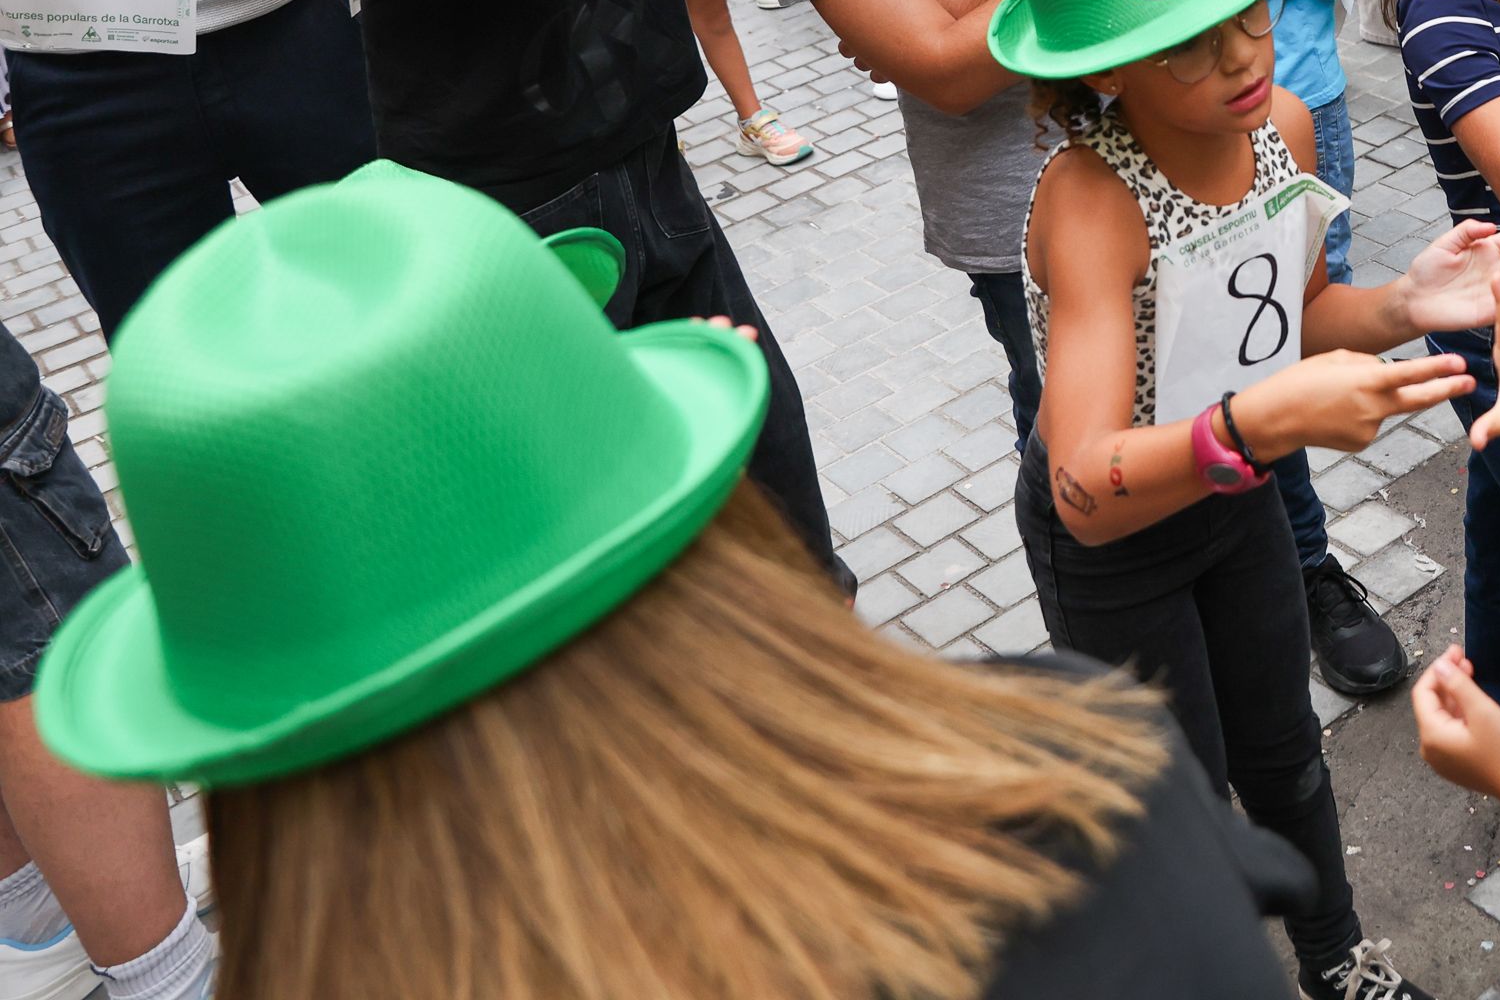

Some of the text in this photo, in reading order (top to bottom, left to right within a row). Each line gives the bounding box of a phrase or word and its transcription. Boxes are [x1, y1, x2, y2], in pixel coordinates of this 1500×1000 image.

[6, 10, 180, 28] curses populars de la Garrotxa
[1179, 208, 1258, 256] CONSELL ESPORTIU
[1213, 222, 1260, 252] Garrotxa
[1227, 252, 1289, 366] 8
